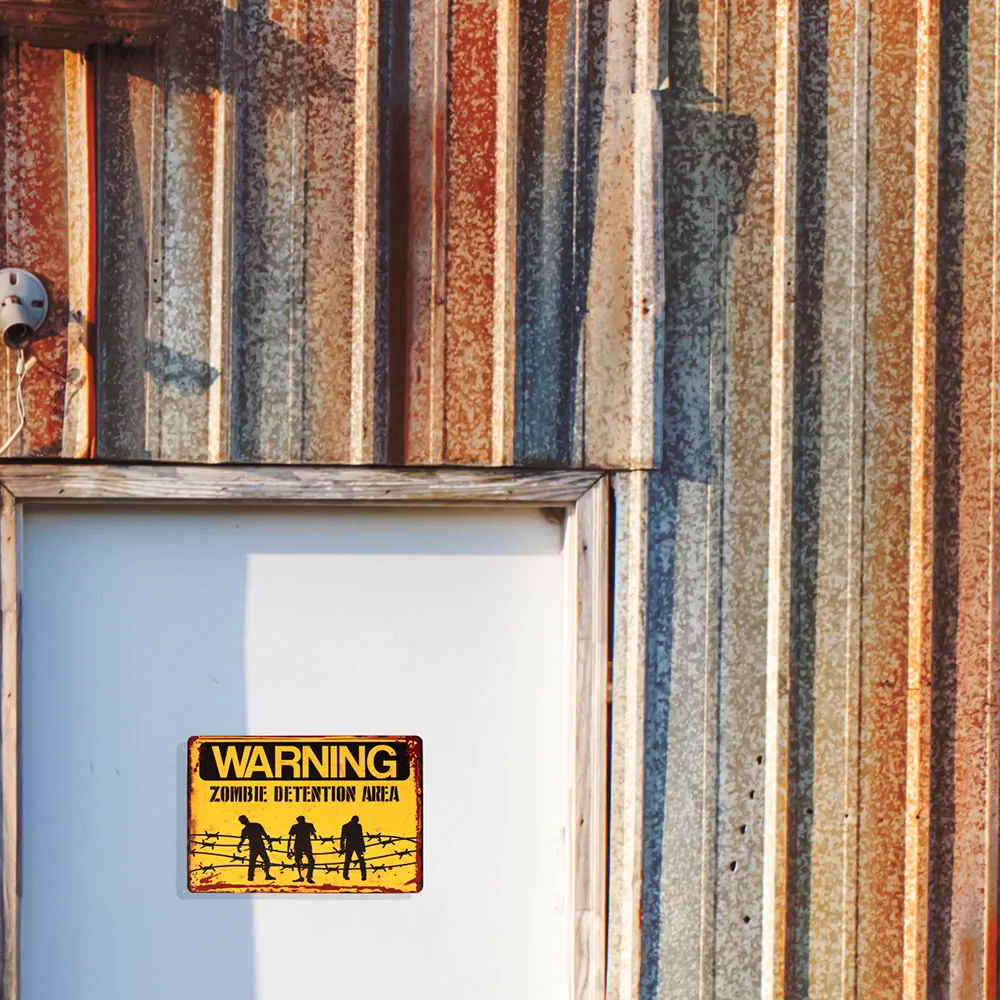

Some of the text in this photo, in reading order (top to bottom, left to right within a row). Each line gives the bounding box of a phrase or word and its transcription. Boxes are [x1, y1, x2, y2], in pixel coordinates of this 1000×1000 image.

[211, 744, 397, 779] WARNING
[209, 786, 400, 803] ZOMBIE DETENTION AREA
